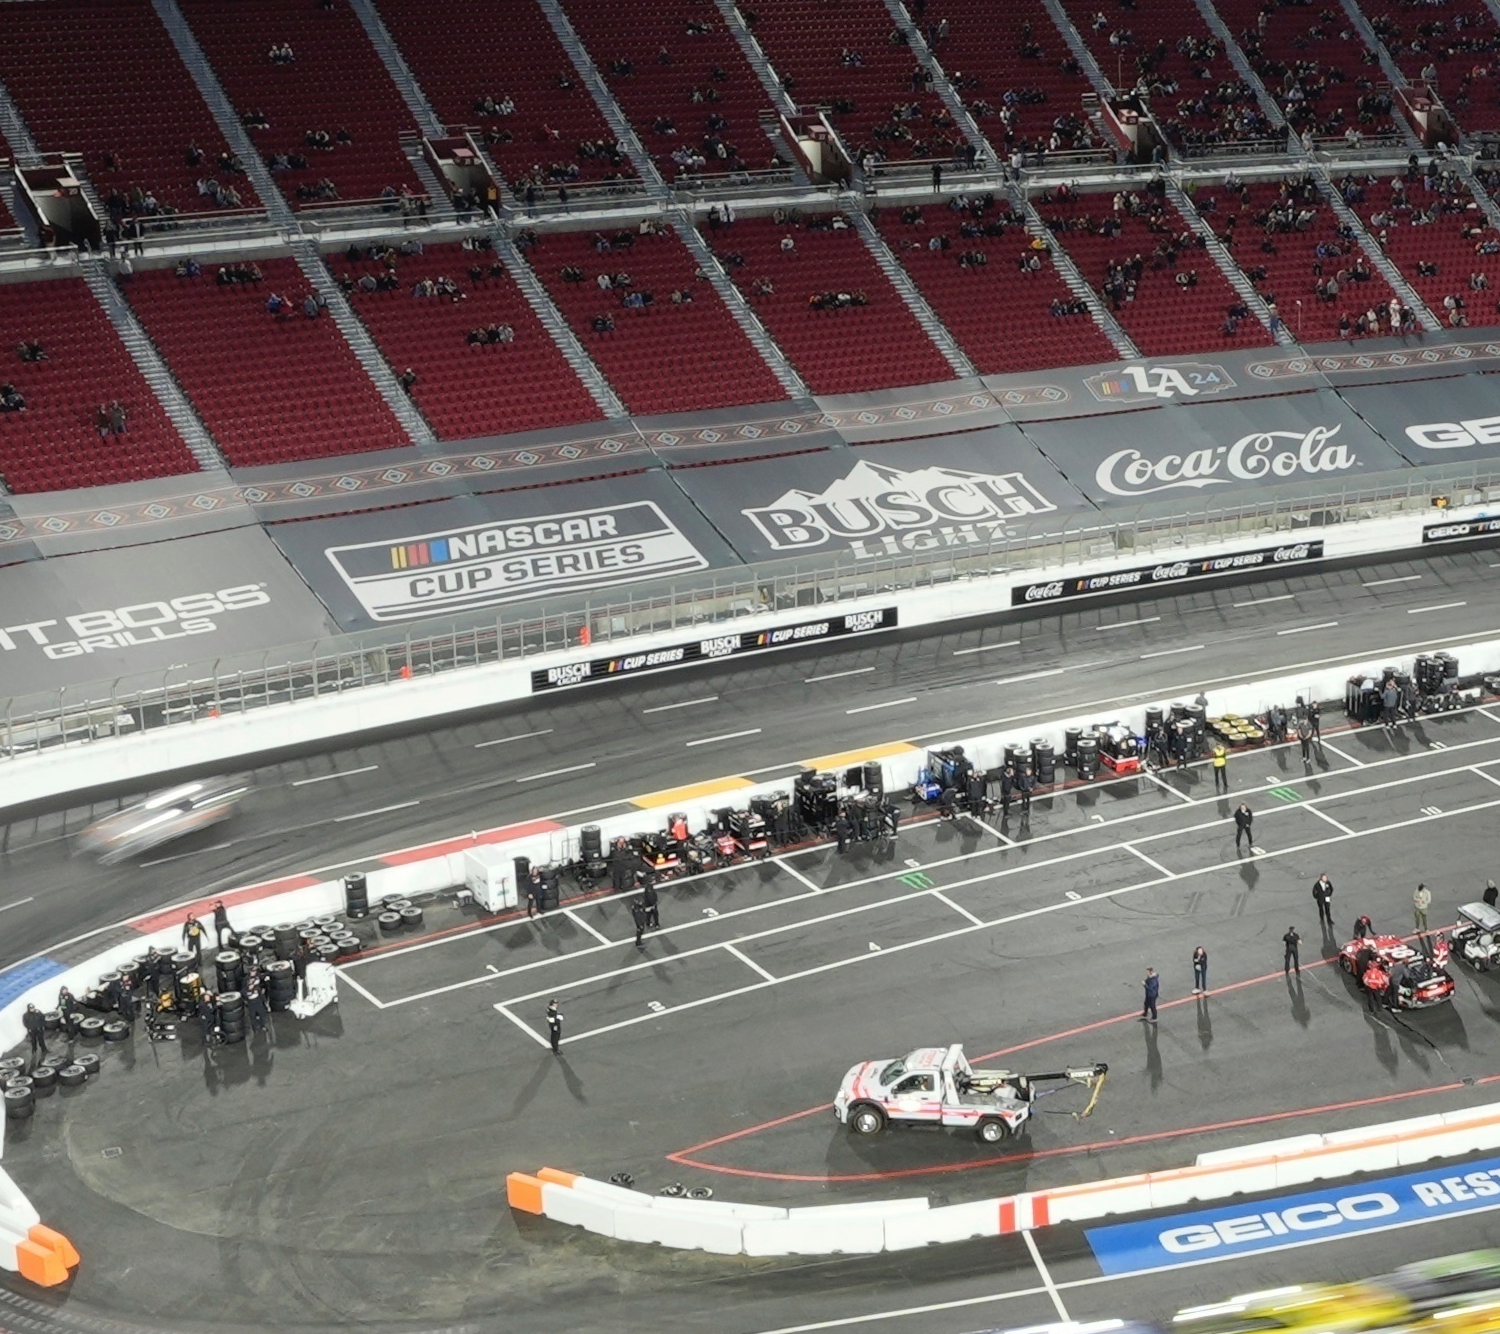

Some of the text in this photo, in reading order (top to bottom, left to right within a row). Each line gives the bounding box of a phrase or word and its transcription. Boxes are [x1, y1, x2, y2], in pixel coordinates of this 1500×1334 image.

[1123, 366, 1221, 399] LA 24
[1095, 422, 1357, 497] Coca-Cola
[741, 471, 1058, 551] BUSCH
[445, 513, 620, 561] NASCAR
[847, 517, 1008, 560] LIGHT
[407, 543, 646, 601] CUP SERIES
[64, 581, 272, 636] BOSS
[844, 610, 883, 629] BUSCH
[41, 616, 218, 661] GRILLS
[699, 634, 742, 654] BUSCH
[772, 622, 830, 644] CUP SERIES
[623, 647, 684, 670] CUP SERIES
[547, 662, 591, 682] BUSCH
[1429, 741, 1447, 750] 11
[1091, 814, 1105, 823] 7
[1420, 806, 1443, 815] 10
[486, 964, 499, 973] 1
[647, 1000, 666, 1012] 2
[1157, 1192, 1400, 1256] GEICO
